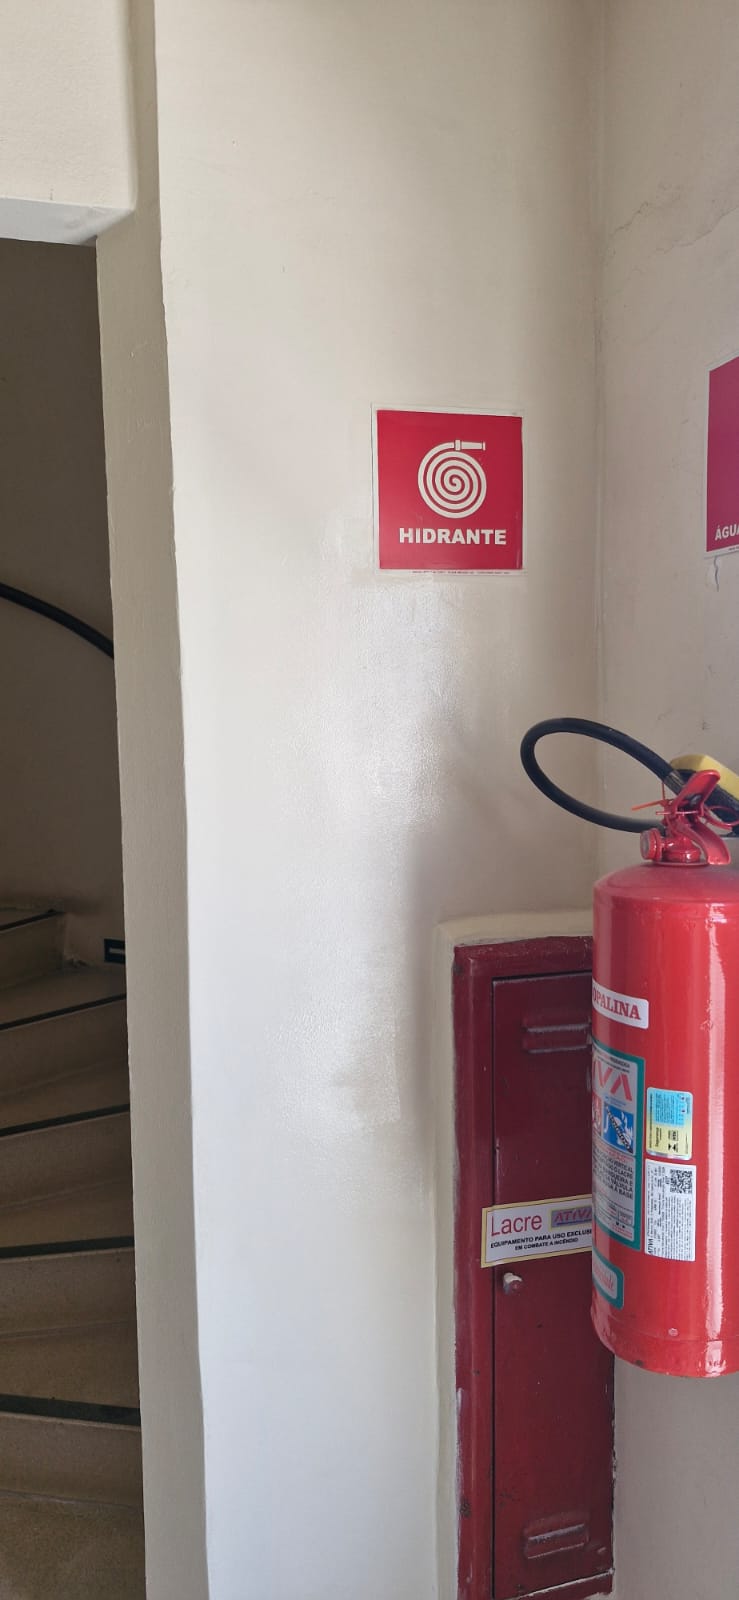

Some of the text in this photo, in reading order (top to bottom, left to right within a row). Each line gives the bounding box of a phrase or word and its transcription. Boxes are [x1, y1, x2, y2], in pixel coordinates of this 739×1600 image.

[399, 527, 507, 545] HIDRANTE
[491, 1215, 542, 1236] Lacre
[490, 1236, 534, 1249] EQUIPAMENTO
[534, 1234, 551, 1242] PARA
[566, 1228, 592, 1238] EXCLUSI
[523, 1241, 549, 1249] COMBATE
